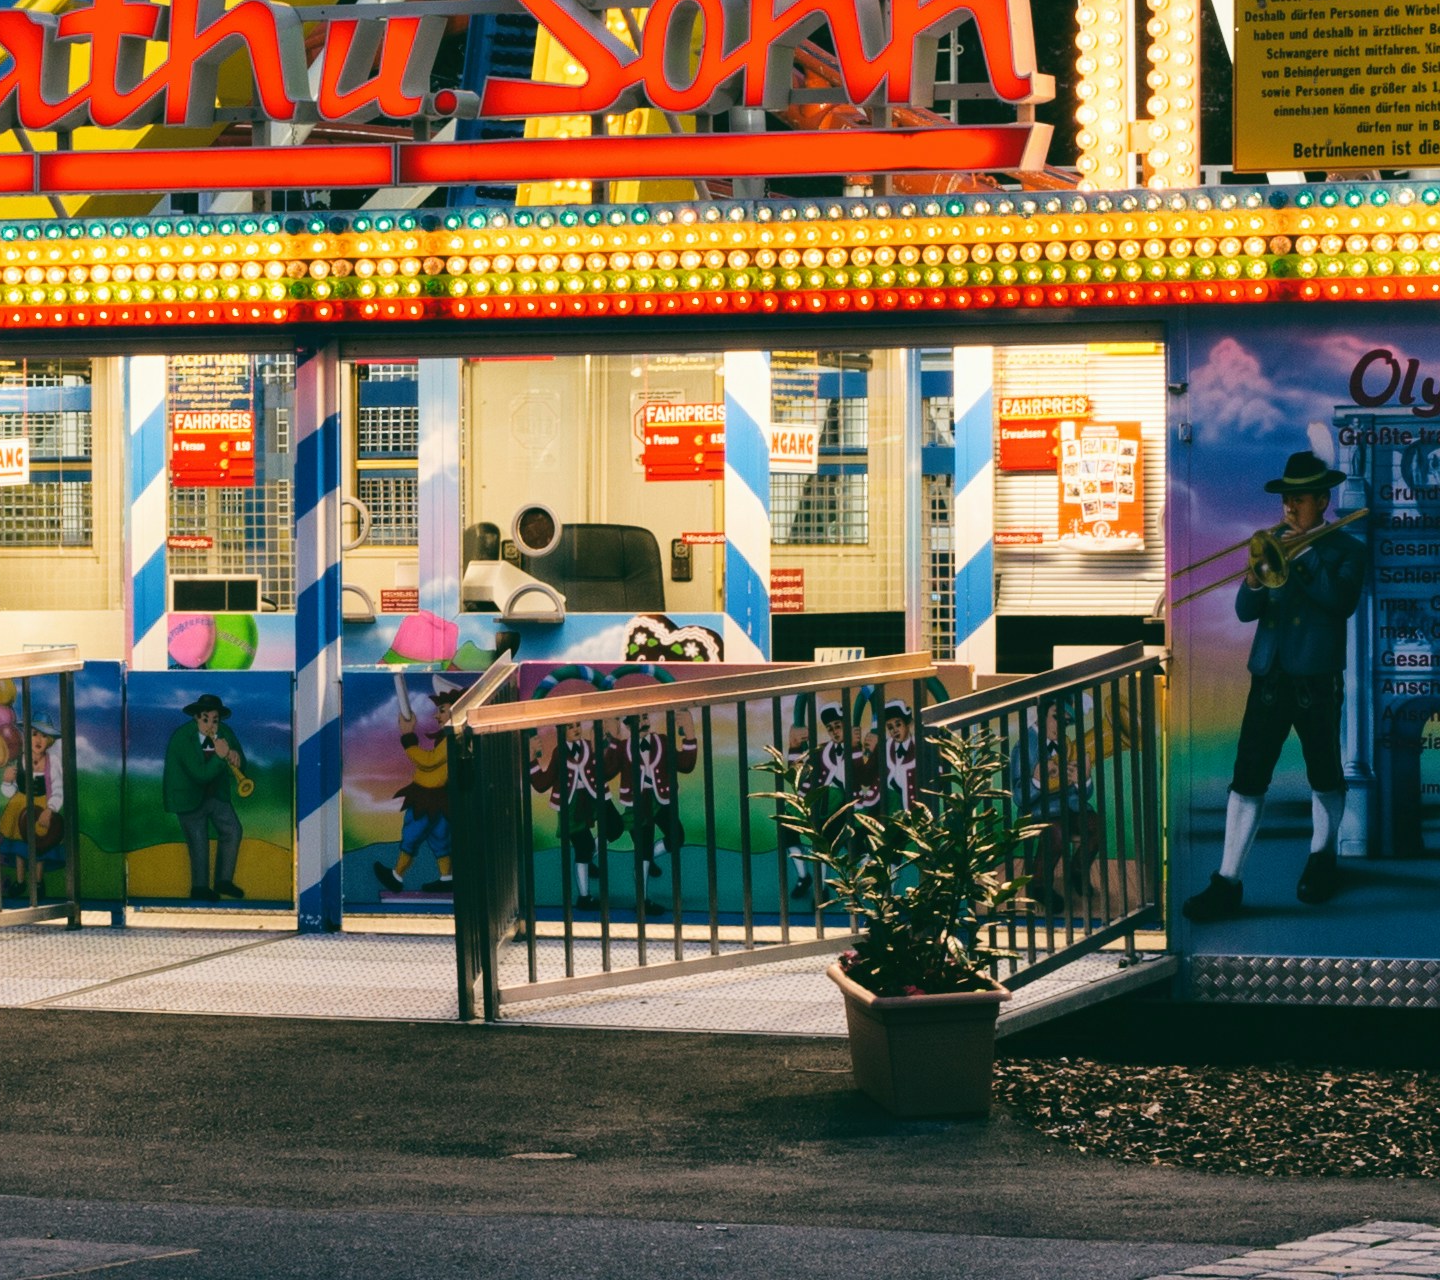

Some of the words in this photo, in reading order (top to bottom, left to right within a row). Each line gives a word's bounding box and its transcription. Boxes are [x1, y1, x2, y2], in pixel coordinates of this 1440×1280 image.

[1245, 7, 1286, 22] Deshalb
[1291, 9, 1325, 20] dürfen
[1330, 8, 1379, 19] Personen
[1384, 6, 1399, 17] die
[1254, 30, 1284, 40] haben
[1290, 28, 1308, 39] und
[1313, 26, 1353, 38] deshalb
[1358, 26, 1368, 37] in
[1373, 24, 1424, 36] ärztlicher
[1267, 48, 1328, 60] Schwangere
[1334, 46, 1360, 57] nicht
[1365, 44, 1420, 56] mitfahren.
[318, 16, 468, 121] u.
[1262, 70, 1279, 78] von
[1284, 66, 1361, 78] Behinderungen
[1366, 63, 1396, 75] durch
[1401, 63, 1416, 74] die
[1262, 86, 1290, 98] sowie
[1296, 85, 1344, 96] Personen
[1349, 84, 1365, 95] die
[1370, 82, 1406, 96] größer
[1412, 81, 1427, 93] als
[1333, 104, 1370, 114] können
[1376, 101, 1410, 113] dürfen
[1357, 121, 1391, 133] dürfen
[1396, 123, 1413, 132] nur
[1419, 120, 1428, 131] in
[1293, 142, 1385, 158] Betrunkenen
[1392, 140, 1411, 155] ist
[1419, 139, 1440, 155] die
[646, 405, 725, 422] FAHRPREIS
[1002, 397, 1088, 415] FAHRPREIS
[175, 413, 251, 429] FAHRPREIS
[771, 431, 814, 455] NGANG
[1339, 425, 1412, 446] Größte
